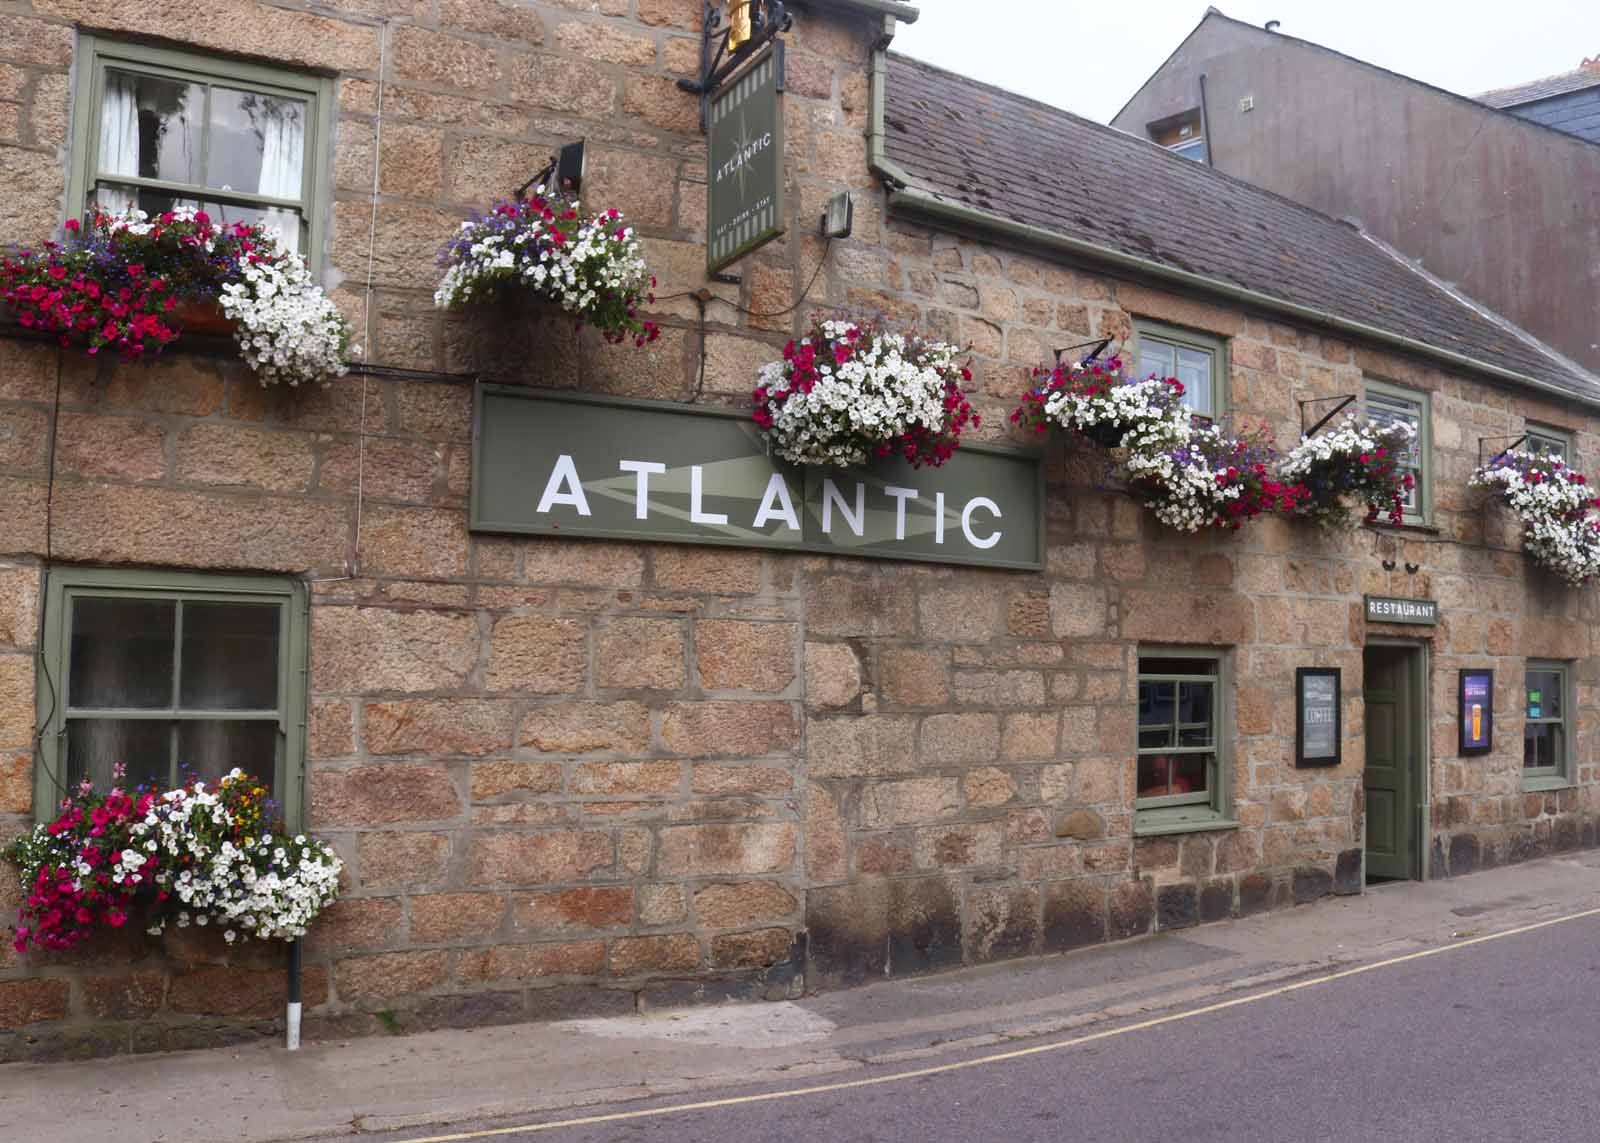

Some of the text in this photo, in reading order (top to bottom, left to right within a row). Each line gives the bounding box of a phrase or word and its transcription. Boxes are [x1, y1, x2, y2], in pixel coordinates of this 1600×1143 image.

[716, 132, 771, 183] ATLANTIC
[536, 454, 1003, 549] ATLANTIC
[1369, 601, 1434, 617] RESTAURANT
